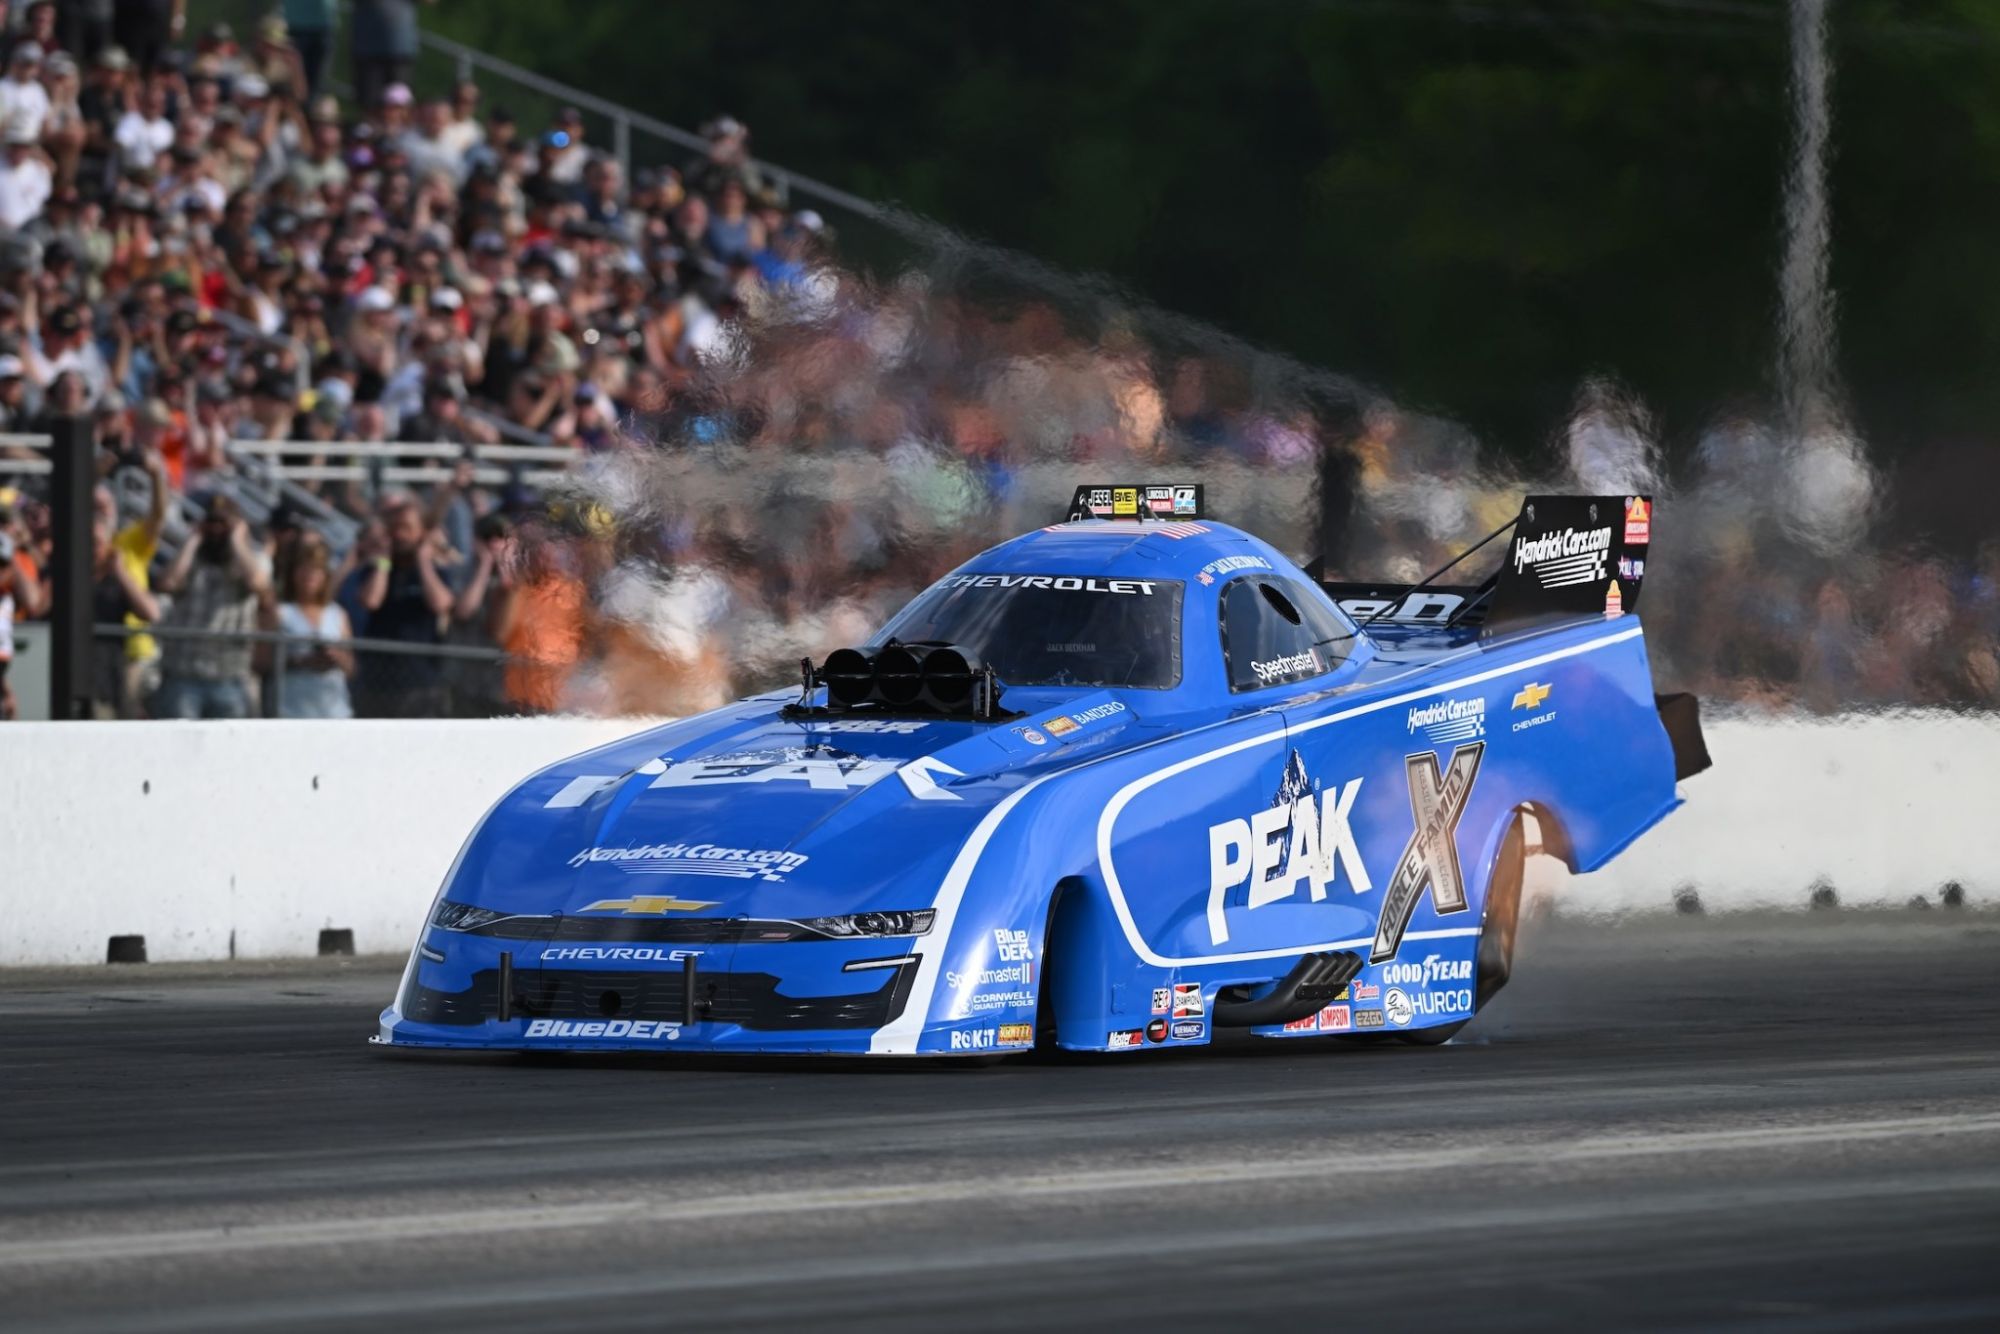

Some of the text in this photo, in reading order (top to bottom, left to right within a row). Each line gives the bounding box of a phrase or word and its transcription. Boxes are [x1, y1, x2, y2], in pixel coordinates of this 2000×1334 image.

[938, 575, 1157, 596] CHEVROLET
[1250, 650, 1314, 683] Speedmaster
[1072, 701, 1126, 725] BANDERO
[1512, 711, 1556, 732] CHEVROLET
[1381, 757, 1466, 943] FORCE FAMILY
[1206, 776, 1373, 947] PEAK
[994, 928, 1026, 944] Blue
[540, 948, 705, 962] CHEVROLET
[973, 991, 1034, 1003] CORNWELL
[973, 999, 1034, 1011] QUALITY TOOLS
[1411, 989, 1472, 1014] HURCO
[1321, 1007, 1349, 1028] SIMPSON
[524, 1019, 683, 1040] BlueDEF
